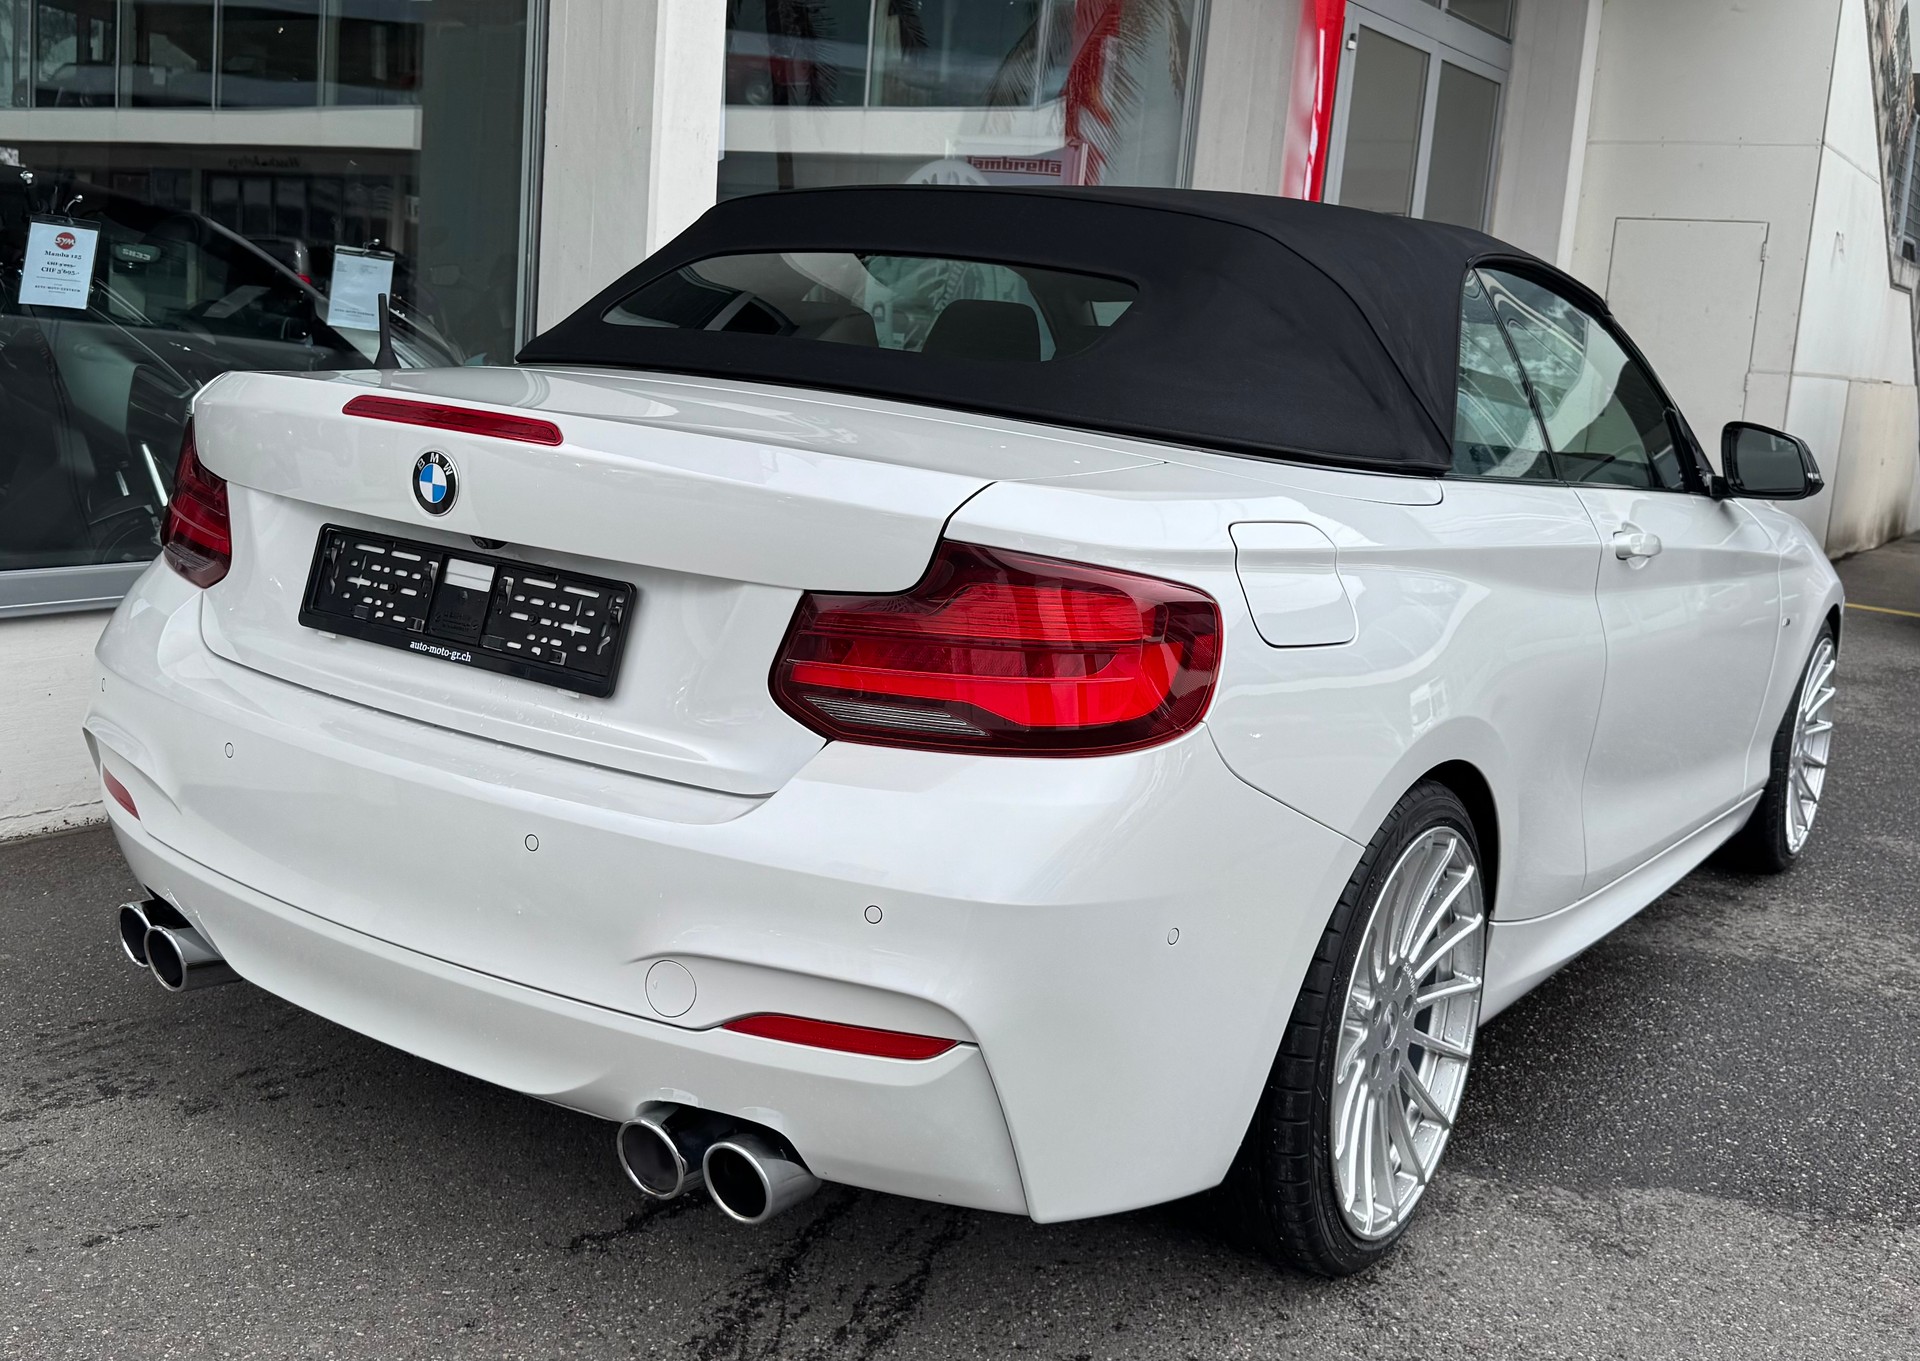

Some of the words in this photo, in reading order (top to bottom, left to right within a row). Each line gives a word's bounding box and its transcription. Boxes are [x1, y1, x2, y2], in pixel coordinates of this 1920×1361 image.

[55, 237, 75, 246] SYM
[45, 250, 70, 258] Mamba
[417, 452, 453, 476] BMW
